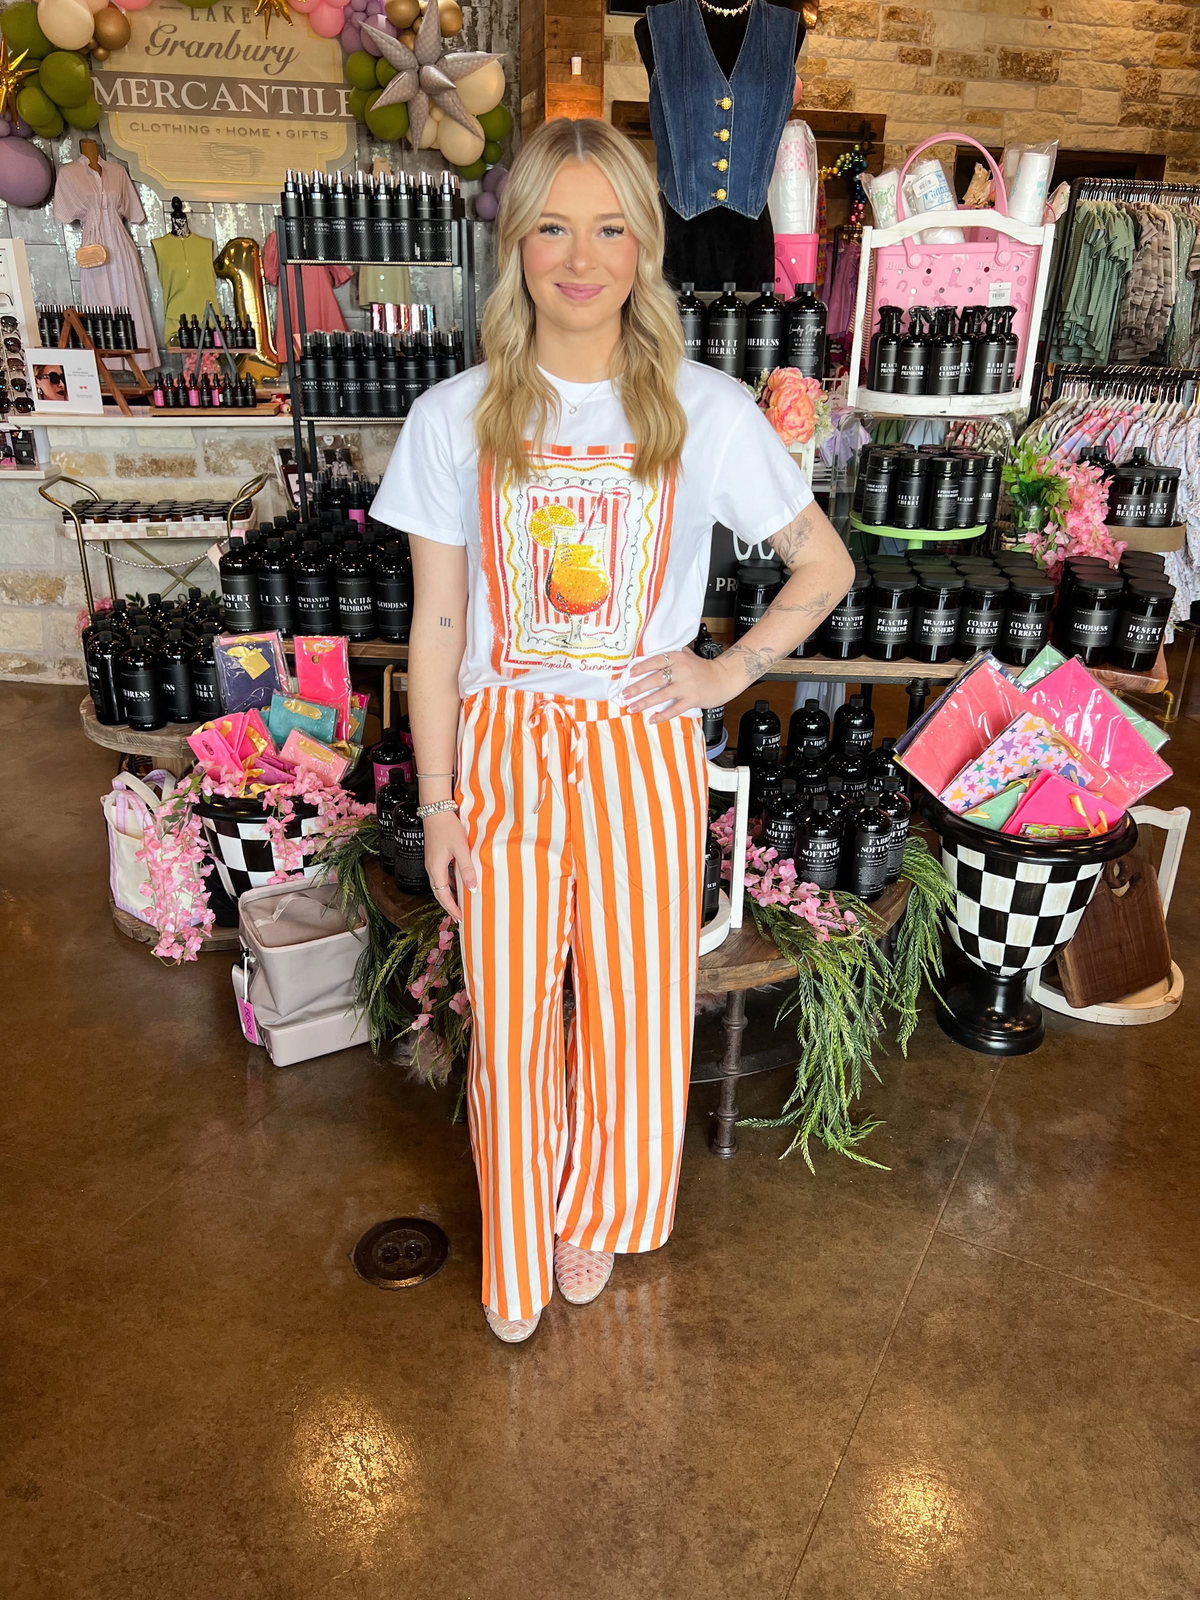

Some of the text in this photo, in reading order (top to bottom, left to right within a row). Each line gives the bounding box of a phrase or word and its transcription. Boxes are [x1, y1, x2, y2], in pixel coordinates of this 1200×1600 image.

[190, 5, 252, 24] LAKE
[145, 21, 300, 76] Granbury
[90, 76, 355, 117] MERCANTILE
[129, 121, 329, 140] CLOTHING HOME GIFTS
[707, 338, 739, 347] VELVET
[747, 338, 780, 347] HEIRESS
[706, 346, 738, 356] CHERRY
[1116, 503, 1147, 511] BERRY
[1115, 509, 1146, 517] BELLINI
[260, 594, 291, 603] LUXE
[339, 604, 372, 612] PRIMROSE
[376, 600, 408, 609] GODDESS
[923, 618, 956, 626] BRAZILIAN
[967, 619, 999, 628] COASTAL
[1010, 621, 1043, 630] COASTAL
[876, 625, 908, 633] PRIMROSE
[921, 625, 955, 634] SUMMERS
[966, 627, 998, 635] CURRENT
[1074, 622, 1109, 632] GODDESS
[1128, 624, 1162, 635] DESERT
[1009, 628, 1042, 637] CURRENT
[1126, 631, 1160, 641] DOUX
[541, 656, 611, 671] Tequila Sunrise
[808, 840, 839, 850] FABRIC
[802, 847, 841, 858] SOFTENER
